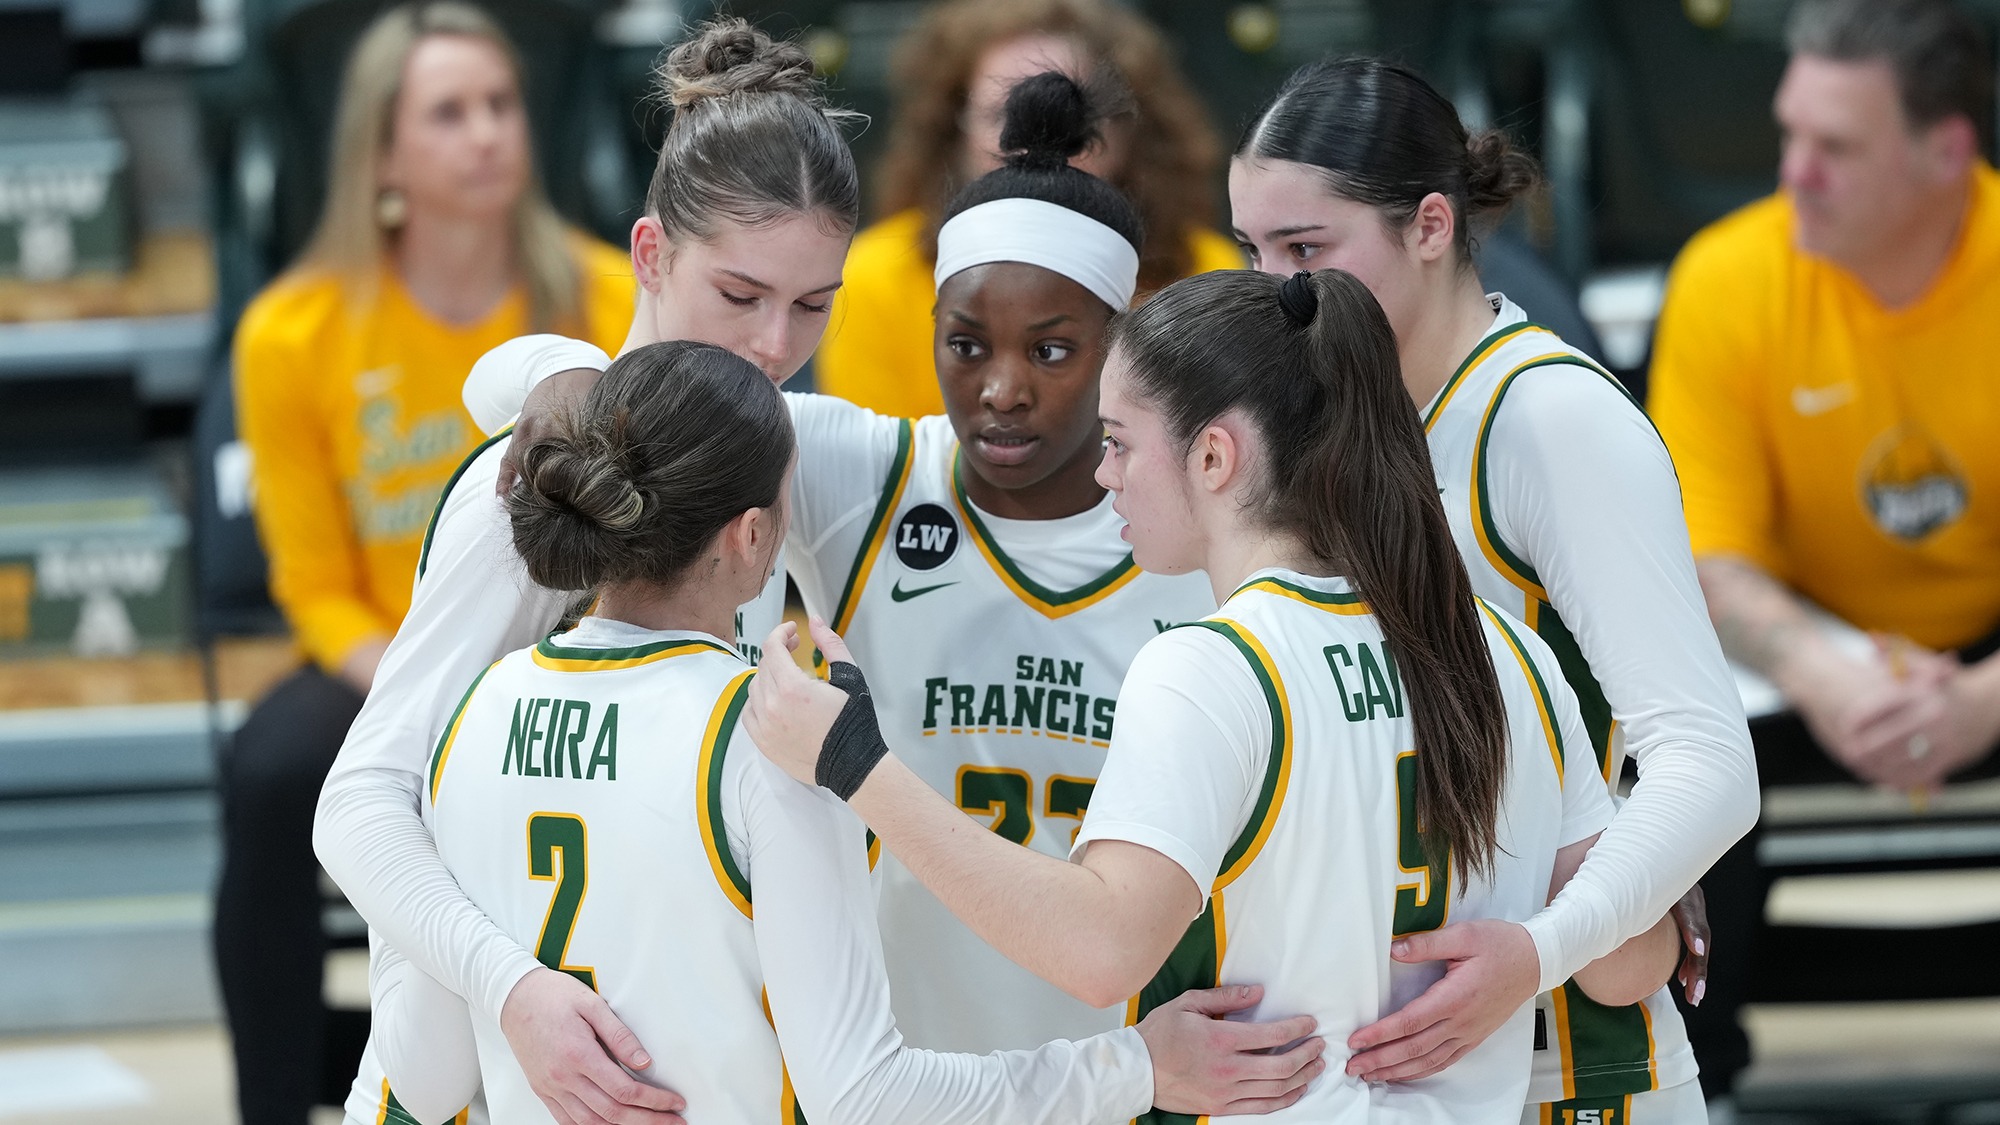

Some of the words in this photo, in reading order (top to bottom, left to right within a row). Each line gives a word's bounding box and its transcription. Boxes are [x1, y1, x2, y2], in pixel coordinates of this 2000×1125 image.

[899, 523, 953, 553] LW
[1016, 655, 1083, 687] SAN
[502, 697, 619, 781] NEIRA
[527, 811, 599, 995] 2
